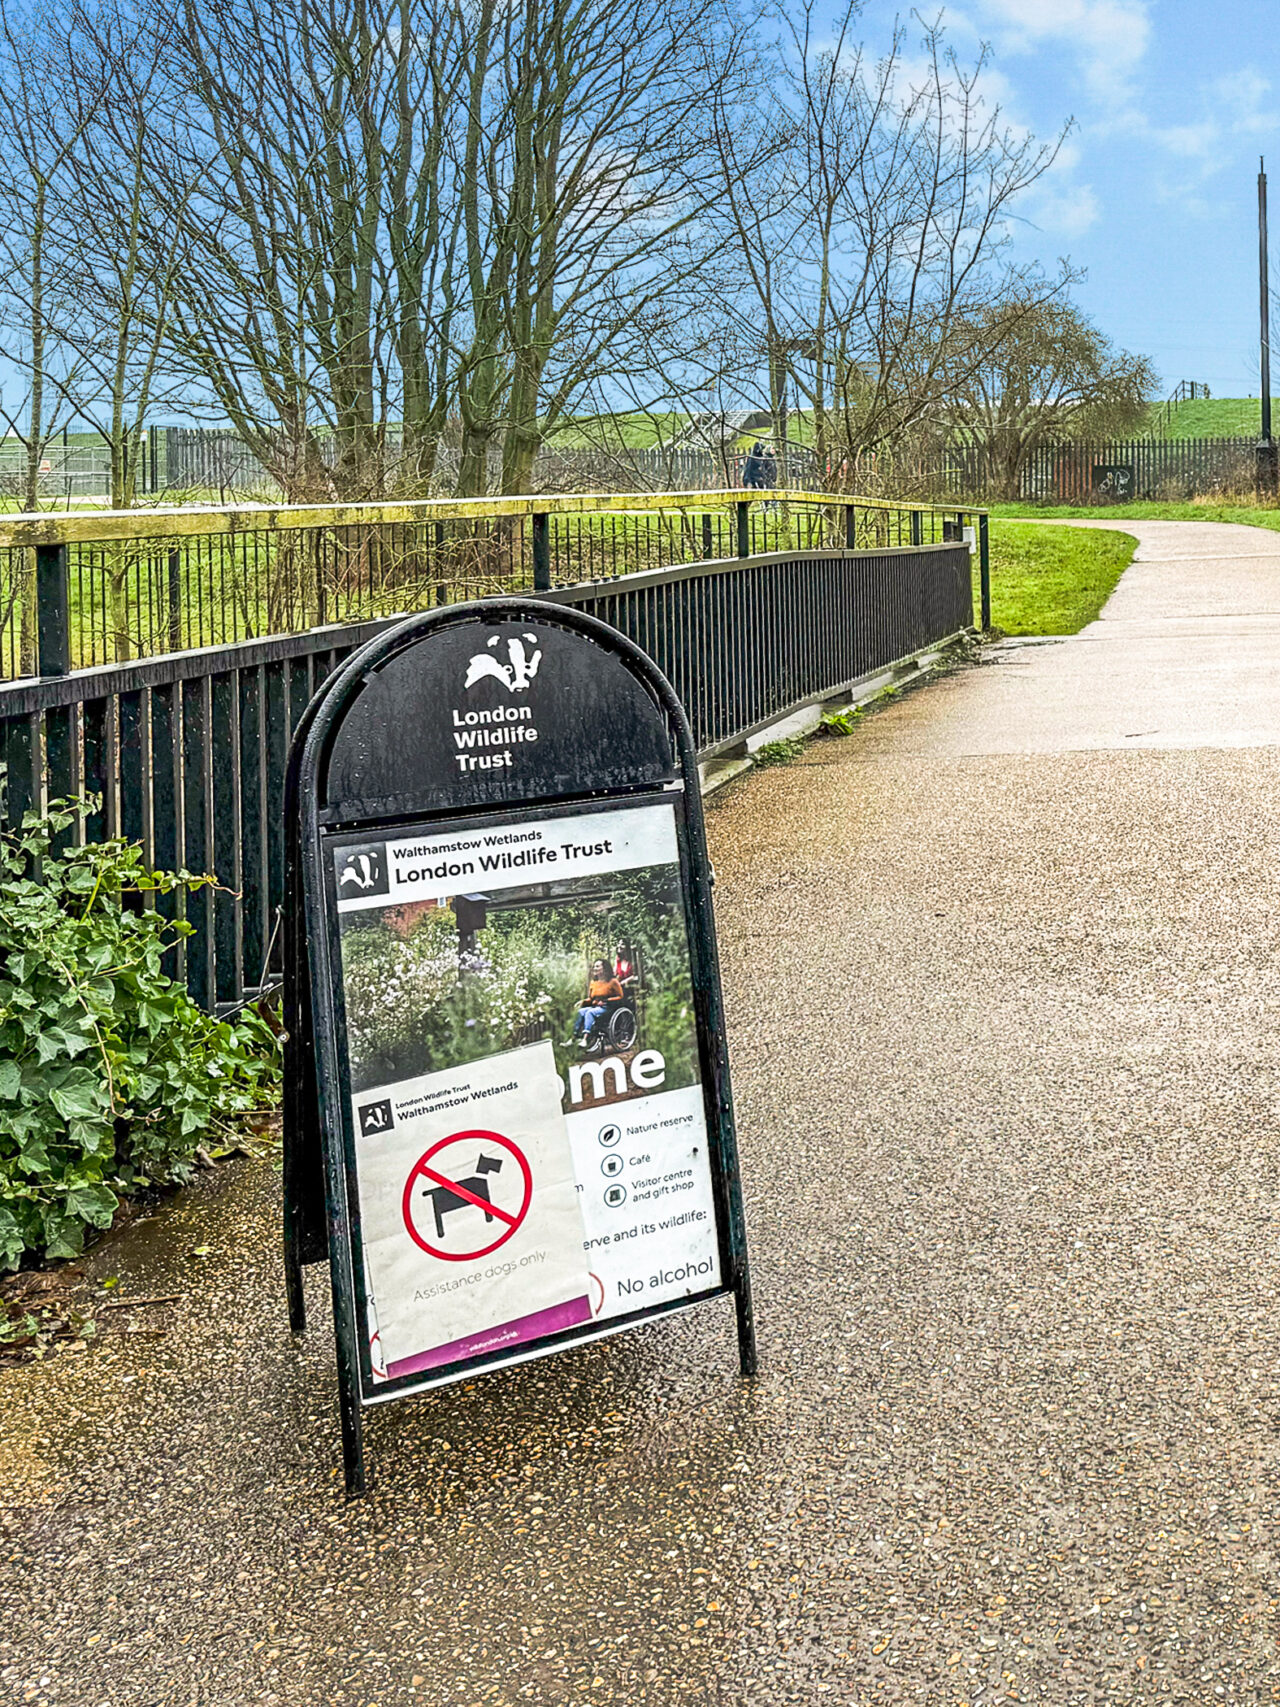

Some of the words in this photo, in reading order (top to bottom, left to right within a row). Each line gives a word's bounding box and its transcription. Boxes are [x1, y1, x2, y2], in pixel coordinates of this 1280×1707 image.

[453, 705, 532, 727] London
[453, 725, 538, 749] Wildlife
[456, 750, 513, 772] Trust
[393, 838, 482, 860] Walthamstow
[483, 829, 543, 848] Wetlands
[395, 861, 475, 885] London
[479, 845, 558, 872] Wildlife
[561, 839, 613, 860] Trust
[560, 1049, 666, 1104] me
[395, 1097, 424, 1109] London
[423, 1089, 452, 1102] Wildlife
[452, 1083, 471, 1094] Trust
[397, 1095, 469, 1121] Walthamstow
[470, 1081, 519, 1101] Wetlands
[626, 1121, 658, 1136] Nature
[660, 1113, 694, 1127] reserve
[629, 1154, 651, 1166] Café
[631, 1177, 662, 1190] Visitor
[663, 1169, 693, 1182] centre
[632, 1190, 651, 1203] and
[652, 1186, 670, 1200] gift
[671, 1180, 695, 1194] shop
[613, 1226, 638, 1242] and
[641, 1222, 656, 1236] its
[658, 1210, 708, 1231] wildlife:
[413, 1270, 483, 1302] Assistance
[484, 1259, 518, 1280] dogs
[520, 1249, 547, 1268] only
[617, 1278, 644, 1297] No
[649, 1256, 714, 1289] alcohol
